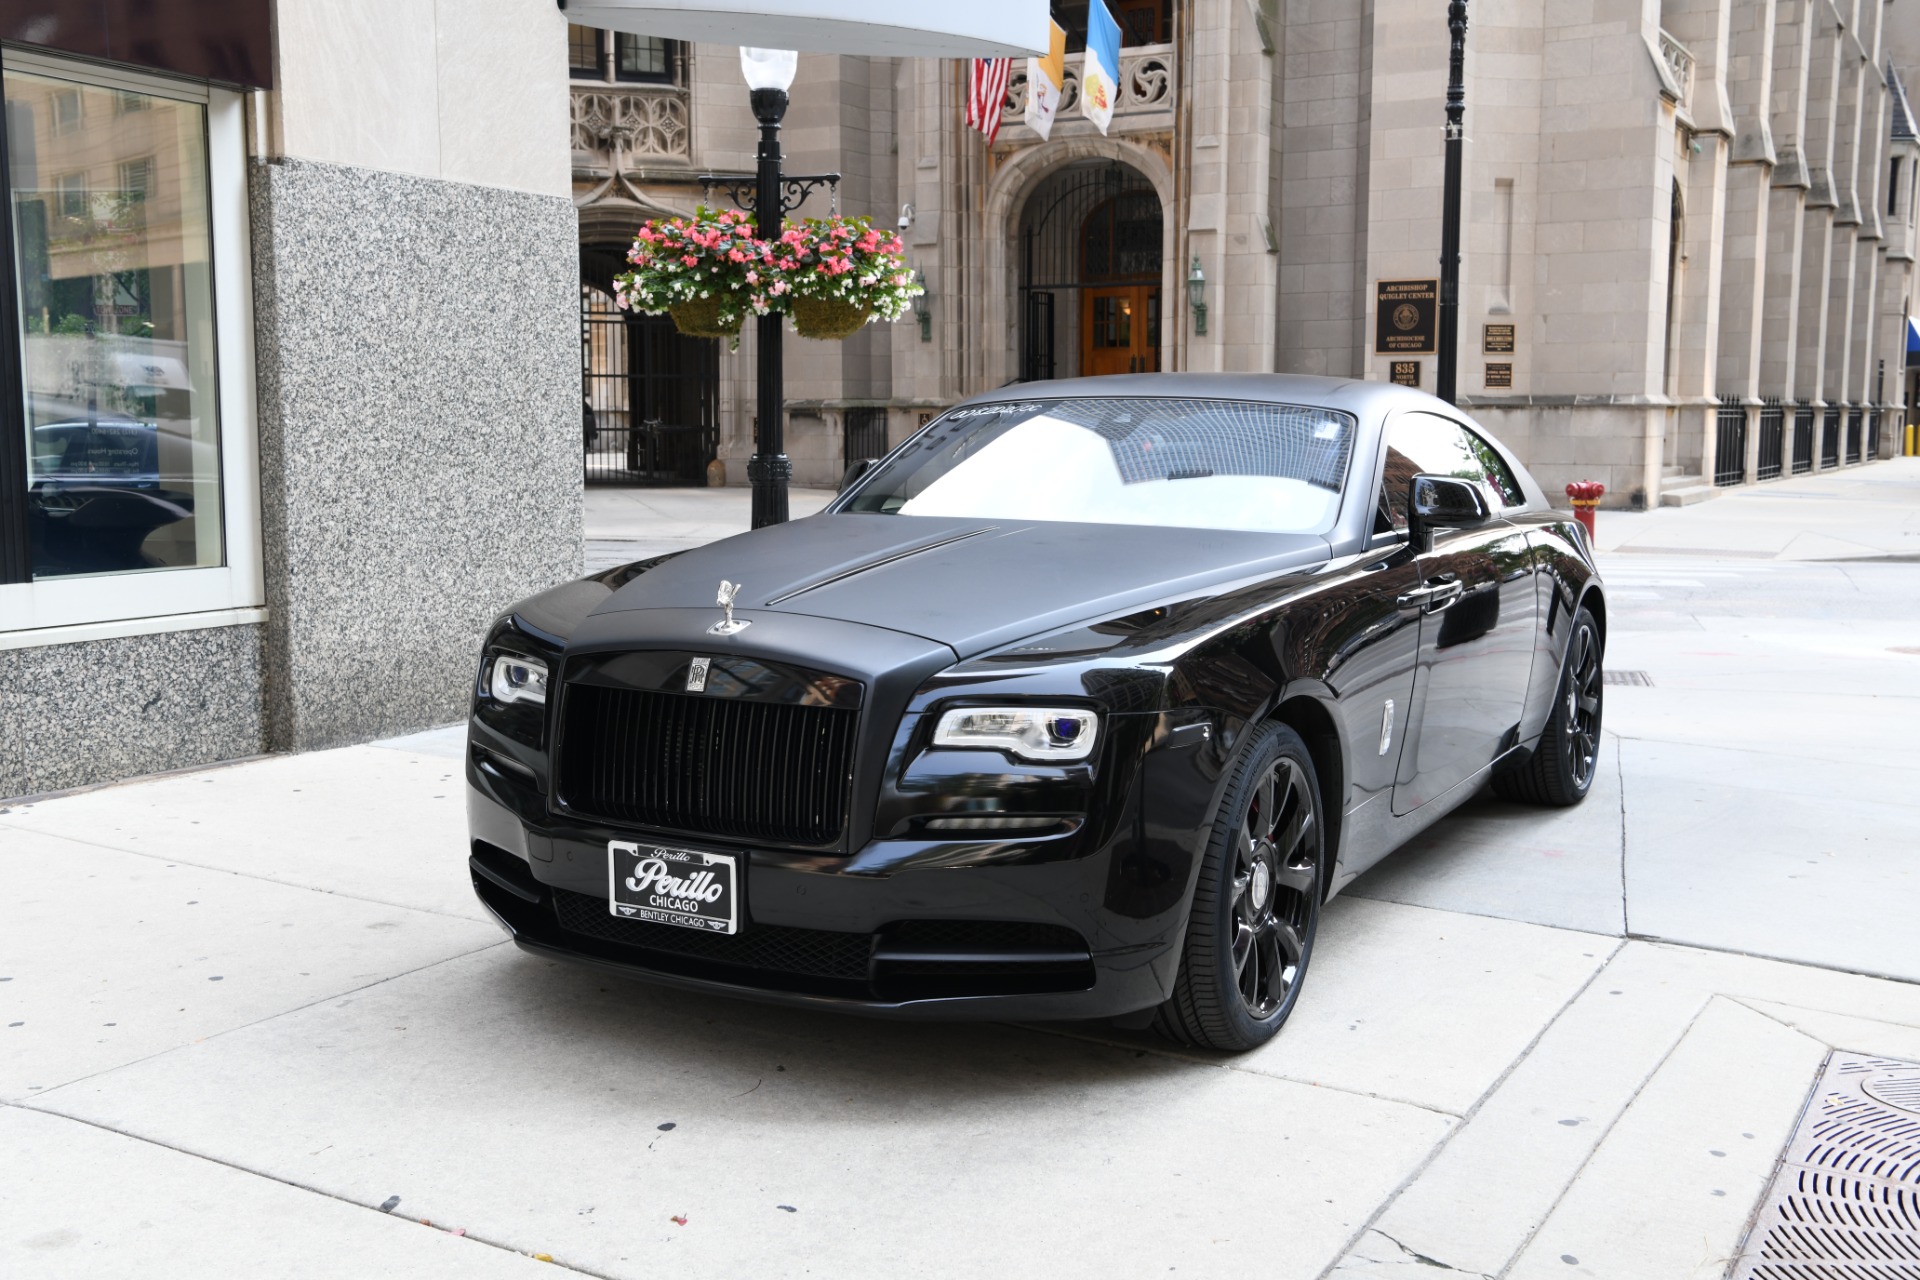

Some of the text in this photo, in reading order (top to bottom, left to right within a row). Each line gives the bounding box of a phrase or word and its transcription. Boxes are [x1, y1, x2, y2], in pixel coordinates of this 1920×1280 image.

[1386, 284, 1428, 292] ARCHBISHOP
[1379, 292, 1408, 301] QUIGLEY
[1395, 363, 1415, 374] 835
[650, 848, 691, 862] Perillo
[625, 858, 723, 903] Perillo
[649, 894, 699, 913] CHICAGO
[640, 909, 705, 928] BENTLEY CHICAGO
